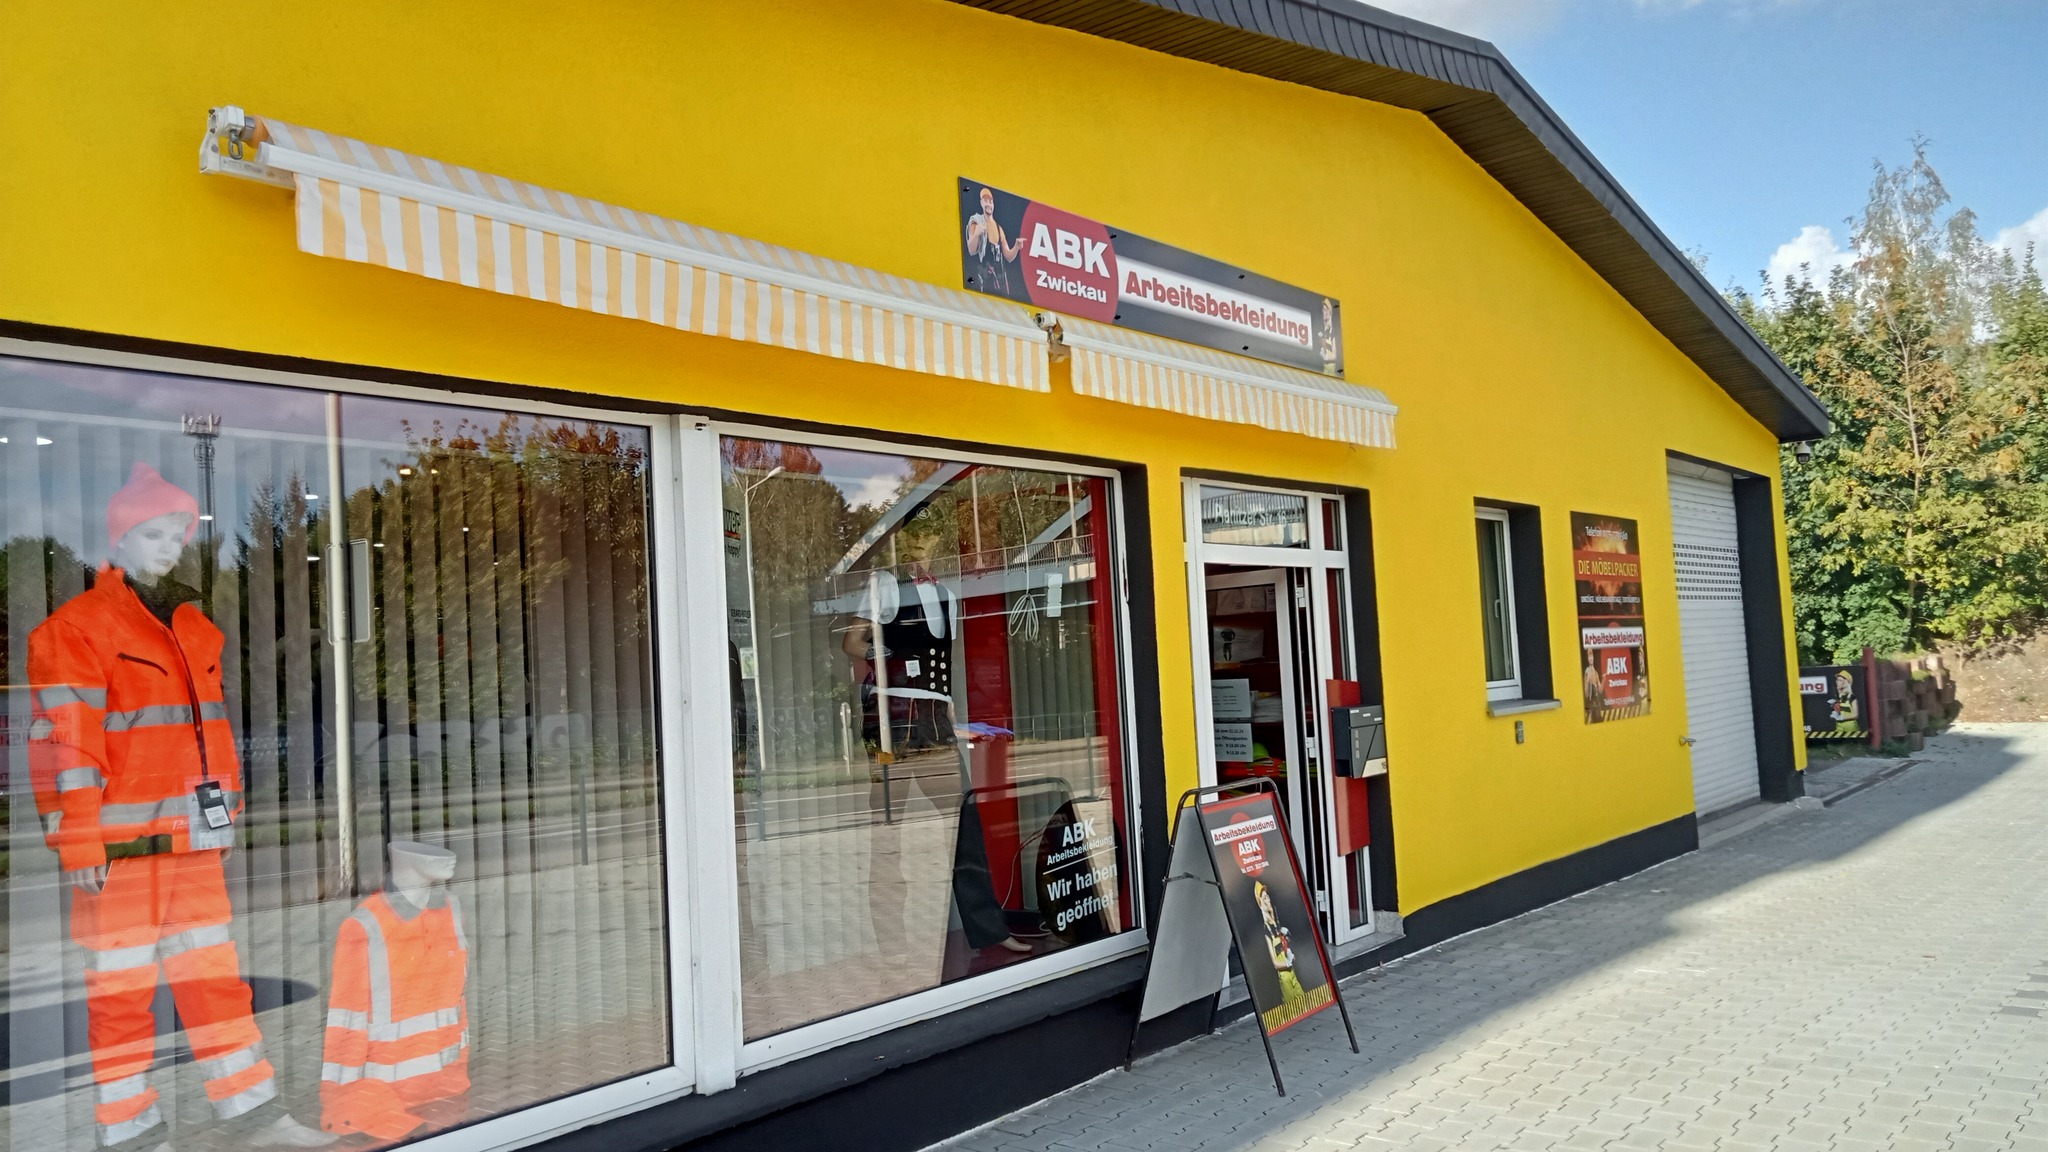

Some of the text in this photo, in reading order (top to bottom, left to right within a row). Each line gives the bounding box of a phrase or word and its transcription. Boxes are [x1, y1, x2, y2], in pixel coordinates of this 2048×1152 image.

[1029, 223, 1110, 279] ABK
[1036, 269, 1107, 304] Zwickau
[1125, 271, 1309, 345] Arbeitsbekleidung
[1578, 558, 1638, 577] DIE MÖBELPACKER
[1585, 632, 1643, 646] Arbeitsbekleidung
[1607, 657, 1628, 675] ABK
[1062, 817, 1097, 848] ABK
[1214, 820, 1275, 842] Arbeitsbekleidung
[1046, 836, 1113, 866] Arbeitsbekleidung
[1238, 838, 1261, 856] ABK
[1046, 862, 1118, 902] Wir haben
[1056, 891, 1115, 932] geöffnet
